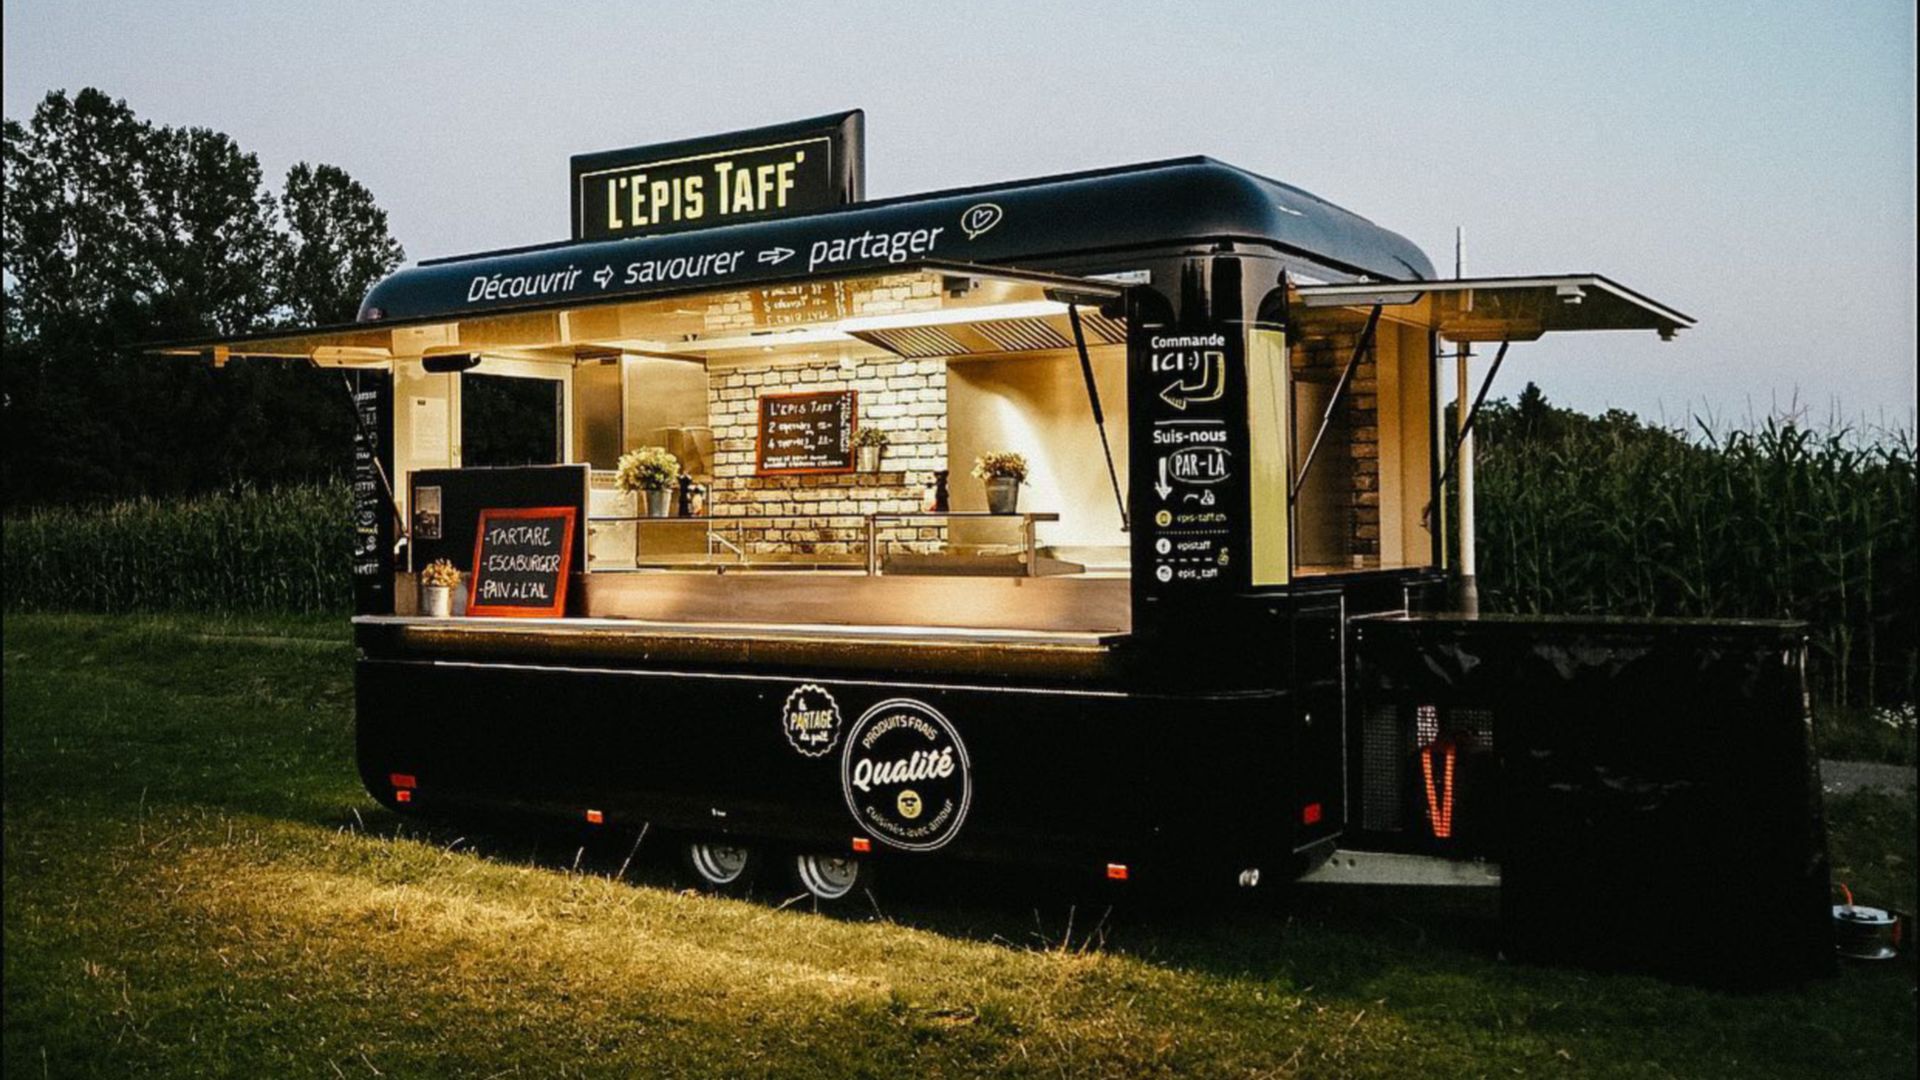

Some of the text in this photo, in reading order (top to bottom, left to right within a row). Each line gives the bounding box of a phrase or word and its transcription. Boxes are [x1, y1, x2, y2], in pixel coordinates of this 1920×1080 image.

[467, 225, 944, 302] Découvrir savourer partager
[1151, 333, 1225, 349] Commande
[1153, 428, 1227, 444] Suis-nous
[1177, 540, 1212, 552] epistaff
[1178, 567, 1219, 580] epis_taff
[790, 709, 834, 731] PARTAGE
[862, 714, 939, 749] PRODUITS FRAIS
[852, 745, 956, 793] Qualité
[906, 826, 930, 838] avec
[928, 798, 953, 832] amour
